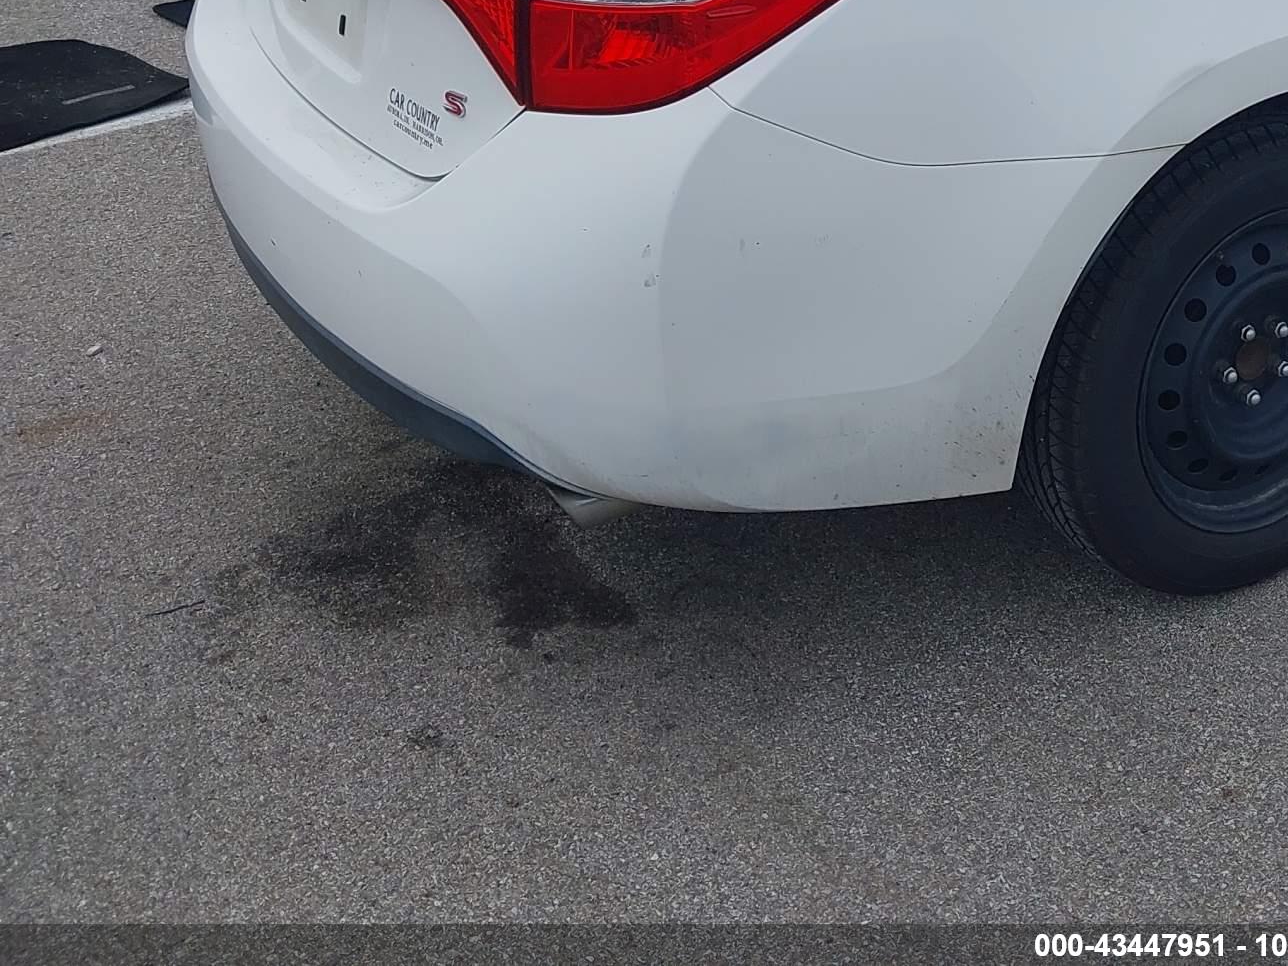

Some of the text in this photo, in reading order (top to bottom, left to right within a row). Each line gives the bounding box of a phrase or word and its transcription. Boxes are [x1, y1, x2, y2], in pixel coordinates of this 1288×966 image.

[390, 88, 440, 132] CAR COUNTRY
[443, 90, 467, 118] S
[393, 119, 433, 149] carcountry.me
